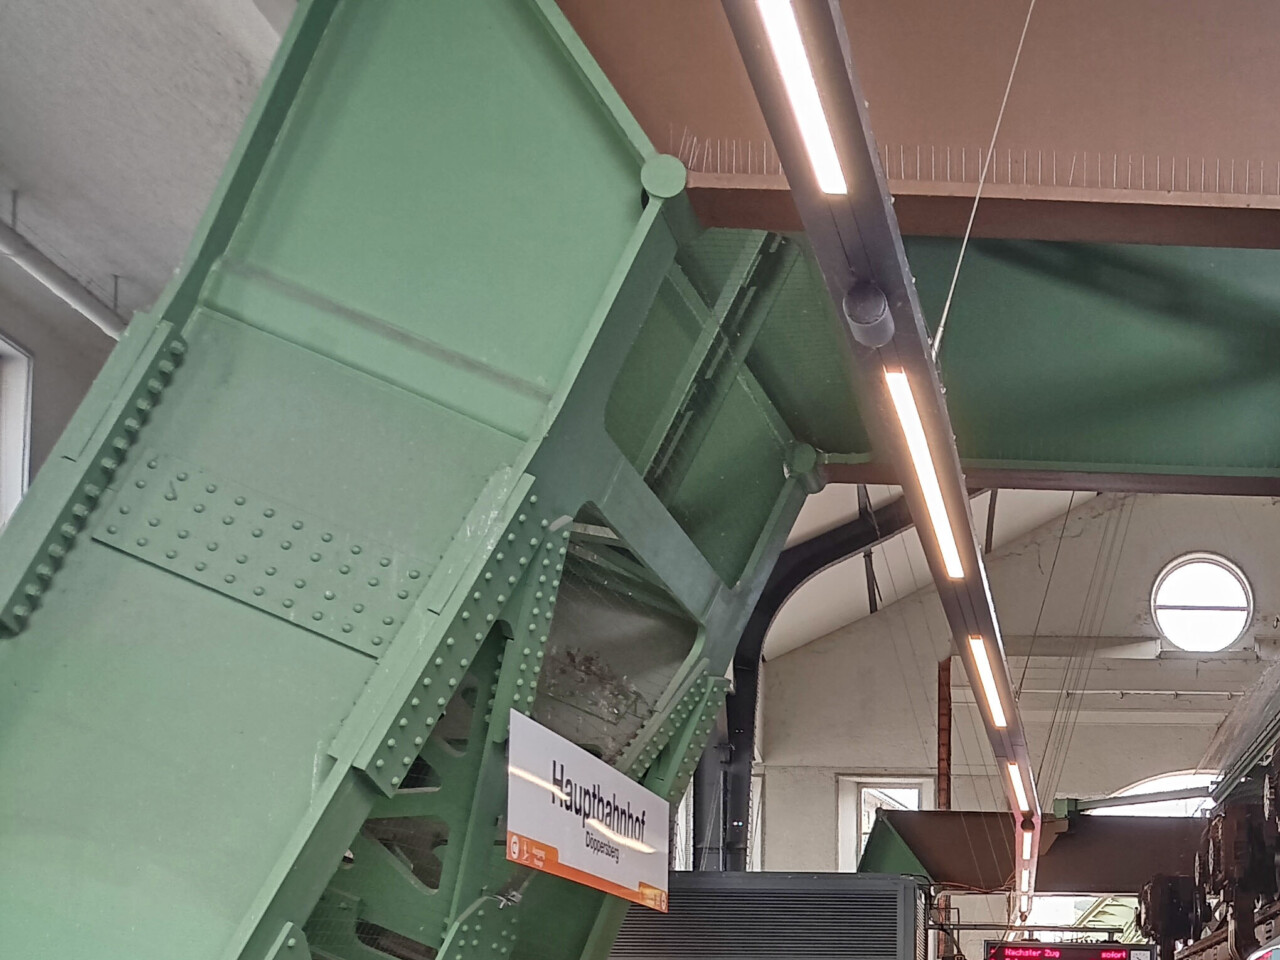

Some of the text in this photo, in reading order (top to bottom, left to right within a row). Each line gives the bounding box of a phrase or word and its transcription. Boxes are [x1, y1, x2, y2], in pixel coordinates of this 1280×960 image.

[552, 760, 646, 844] Hauptbahnhof
[1044, 949, 1060, 958] Zug
[1101, 951, 1126, 959] sofort
